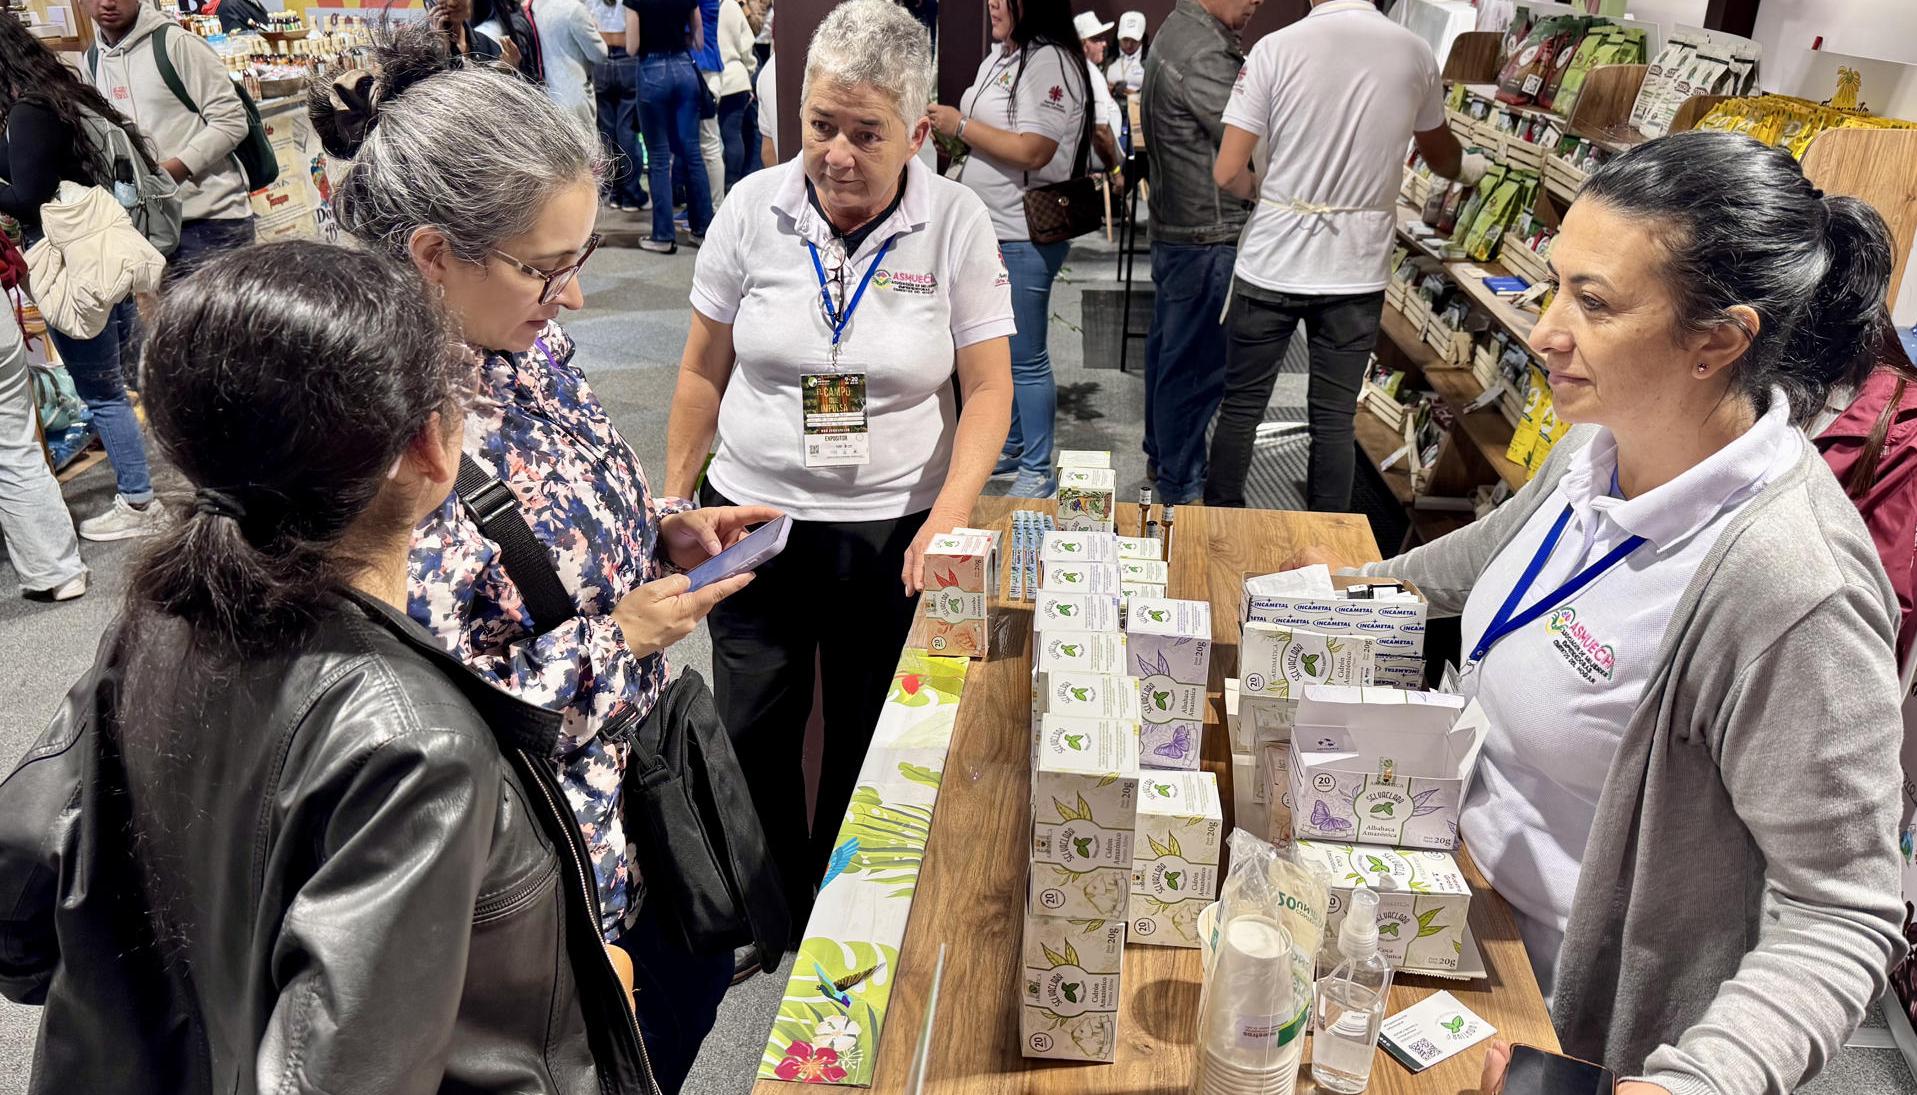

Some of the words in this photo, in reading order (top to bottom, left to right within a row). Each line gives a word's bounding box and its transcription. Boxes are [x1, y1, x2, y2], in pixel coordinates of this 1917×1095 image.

[824, 387, 850, 397] CAMPO
[1254, 601, 1289, 609] INCAMETAL
[1338, 606, 1373, 614] INCAMETAL
[1359, 622, 1395, 630] INCAMETAL
[1364, 640, 1372, 653] 20g
[1379, 638, 1414, 646] INCAMETAL
[1569, 621, 1615, 669] ASMUECH
[1196, 642, 1207, 656] 20g
[1289, 643, 1304, 682] SELVACLARA
[1251, 676, 1259, 687] 20
[1181, 689, 1189, 714] Albahaca
[1318, 777, 1331, 785] 20
[1121, 782, 1134, 799] 20g
[1367, 791, 1404, 804] SELVACLARA
[1207, 822, 1218, 837] 20g
[1059, 827, 1075, 863] SELVACLARA
[1105, 838, 1113, 858] Cidrón
[1113, 832, 1121, 865] Amazónico
[1434, 838, 1451, 846] 20g
[1151, 862, 1166, 894] SELVACLARA
[1191, 872, 1199, 891] Cidrón
[1199, 867, 1207, 897] Amazónico
[1045, 893, 1055, 904] 20
[1376, 912, 1410, 924] ELVACLARA
[1139, 922, 1147, 931] 20
[1107, 928, 1119, 944] 20g
[1440, 958, 1456, 967] 20g
[1099, 977, 1107, 1009] Amazónico
[1034, 1037, 1043, 1047] 20
